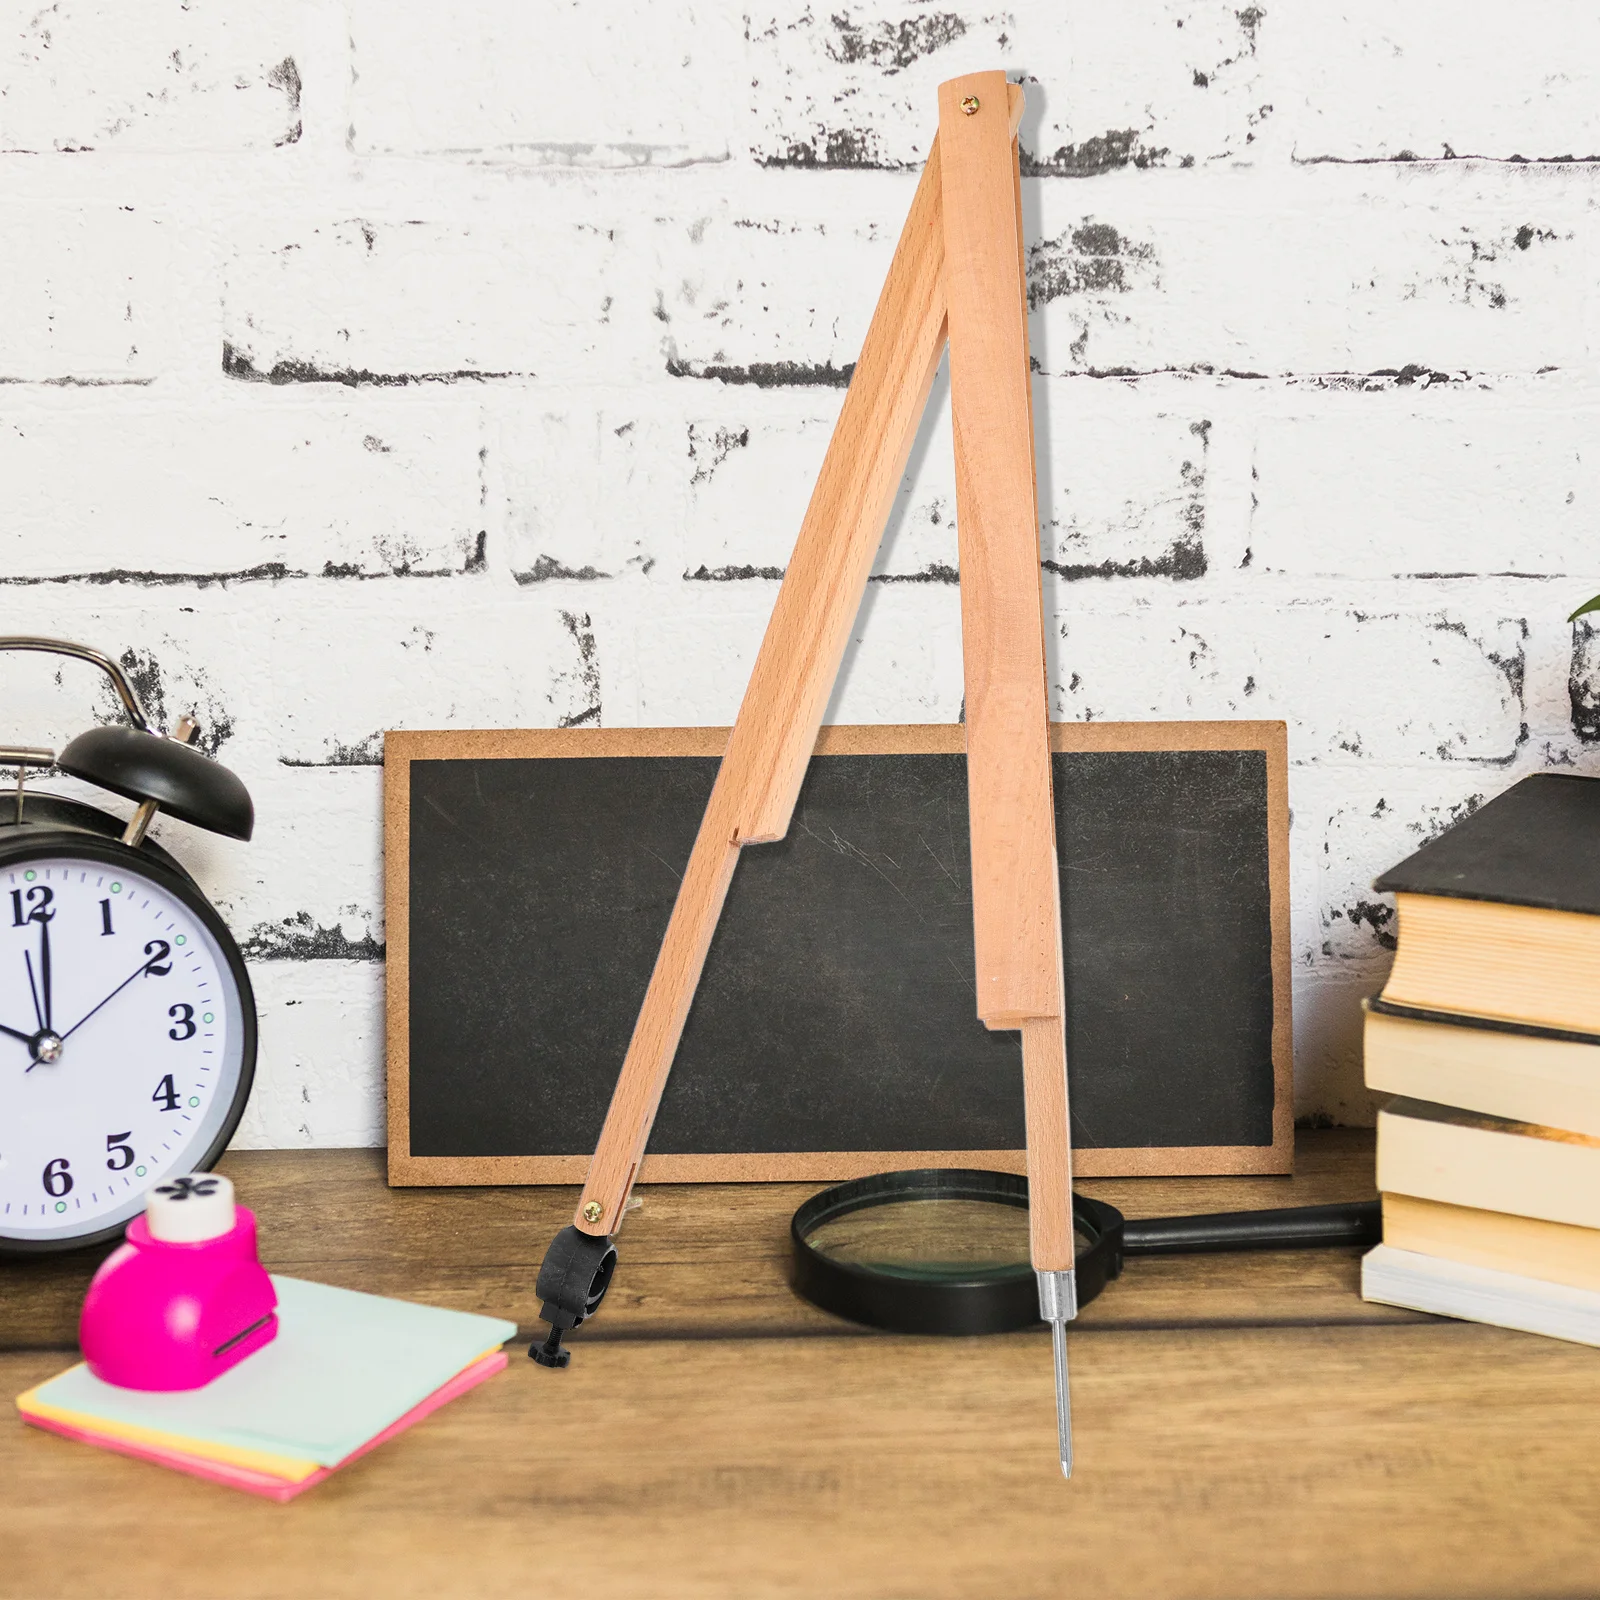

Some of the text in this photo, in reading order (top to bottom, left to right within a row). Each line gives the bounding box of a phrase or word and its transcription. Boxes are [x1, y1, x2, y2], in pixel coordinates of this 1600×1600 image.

[10, 886, 57, 927] 12
[99, 898, 115, 936] 1
[144, 939, 173, 978] 2
[168, 1003, 197, 1040] 3
[152, 1074, 181, 1112] 4
[106, 1131, 135, 1170] 5
[43, 1158, 74, 1197] 6
